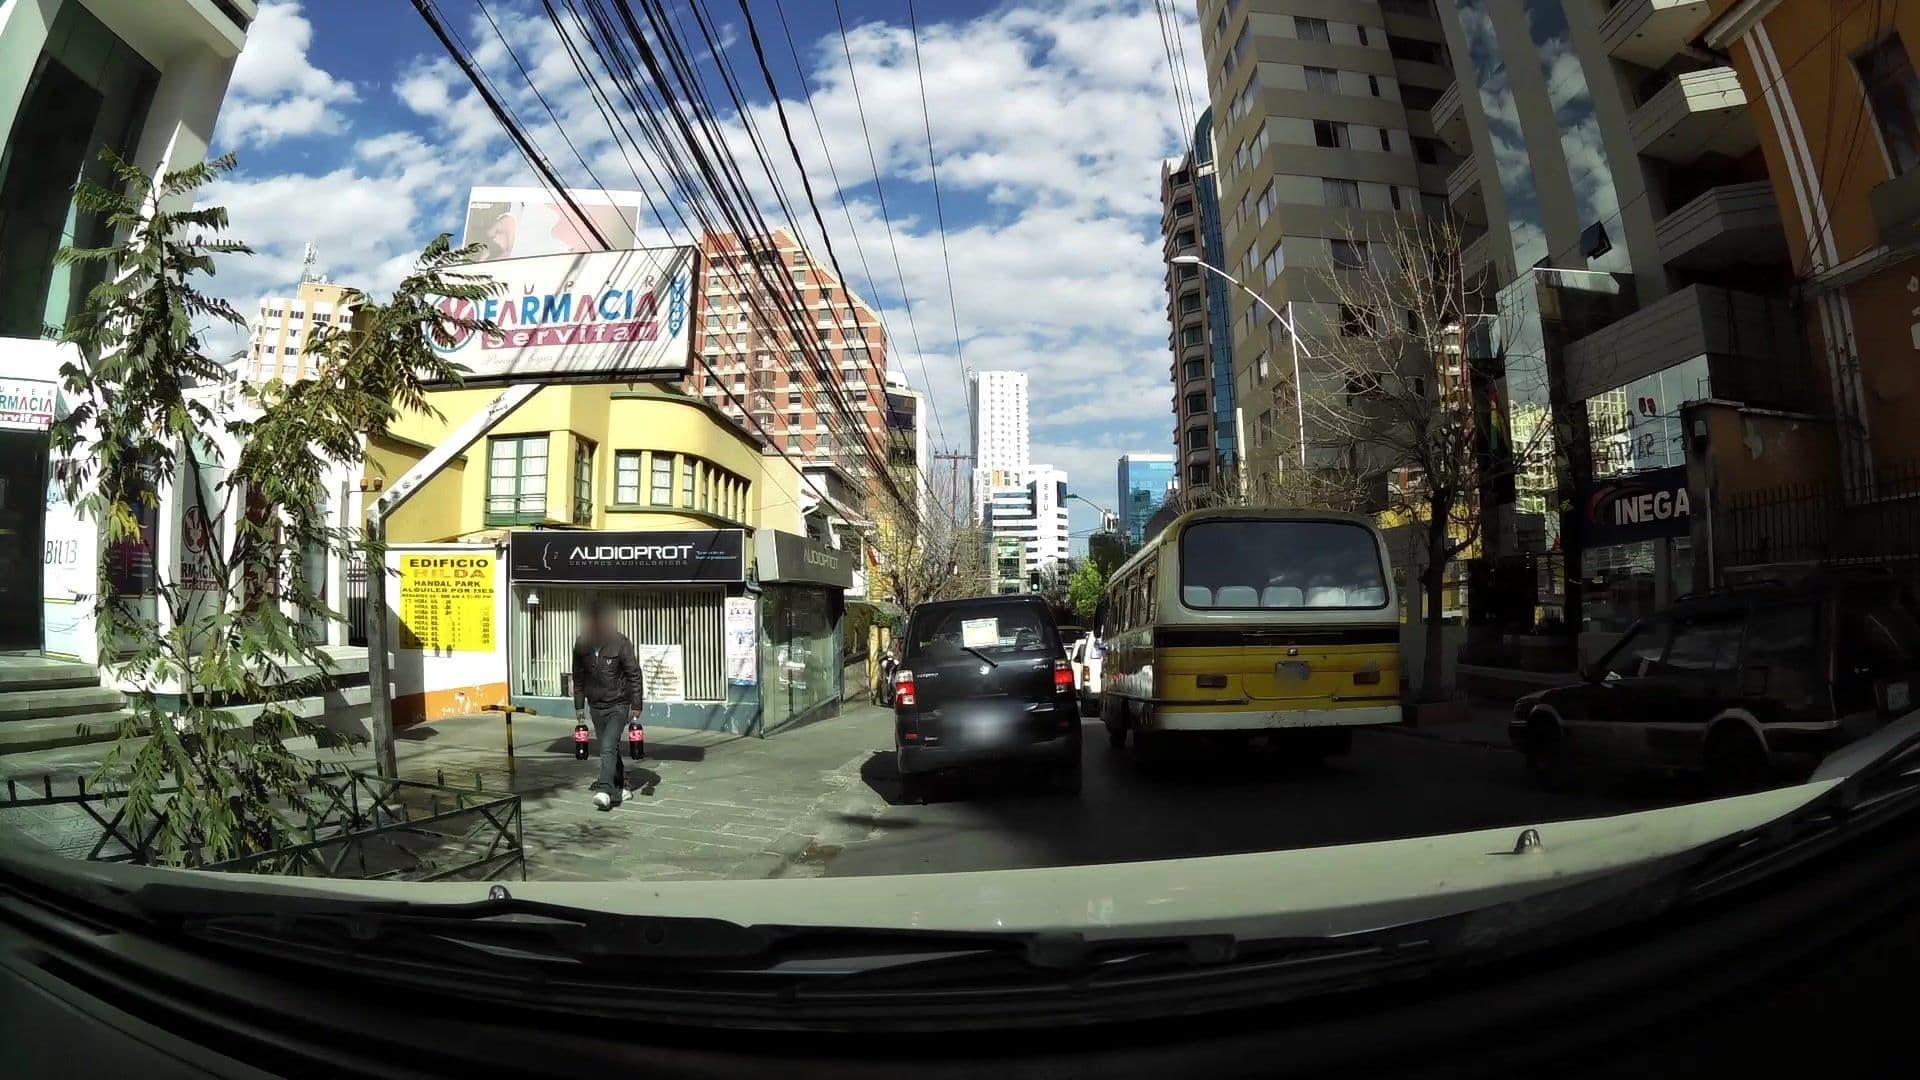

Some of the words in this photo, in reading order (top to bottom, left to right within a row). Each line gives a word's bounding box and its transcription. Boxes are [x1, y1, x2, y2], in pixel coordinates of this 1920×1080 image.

[484, 289, 658, 327] FARMACIA
[570, 545, 693, 560] AUDIOPROT
[409, 558, 489, 568] EDIFICIO
[413, 569, 486, 578] HILDA
